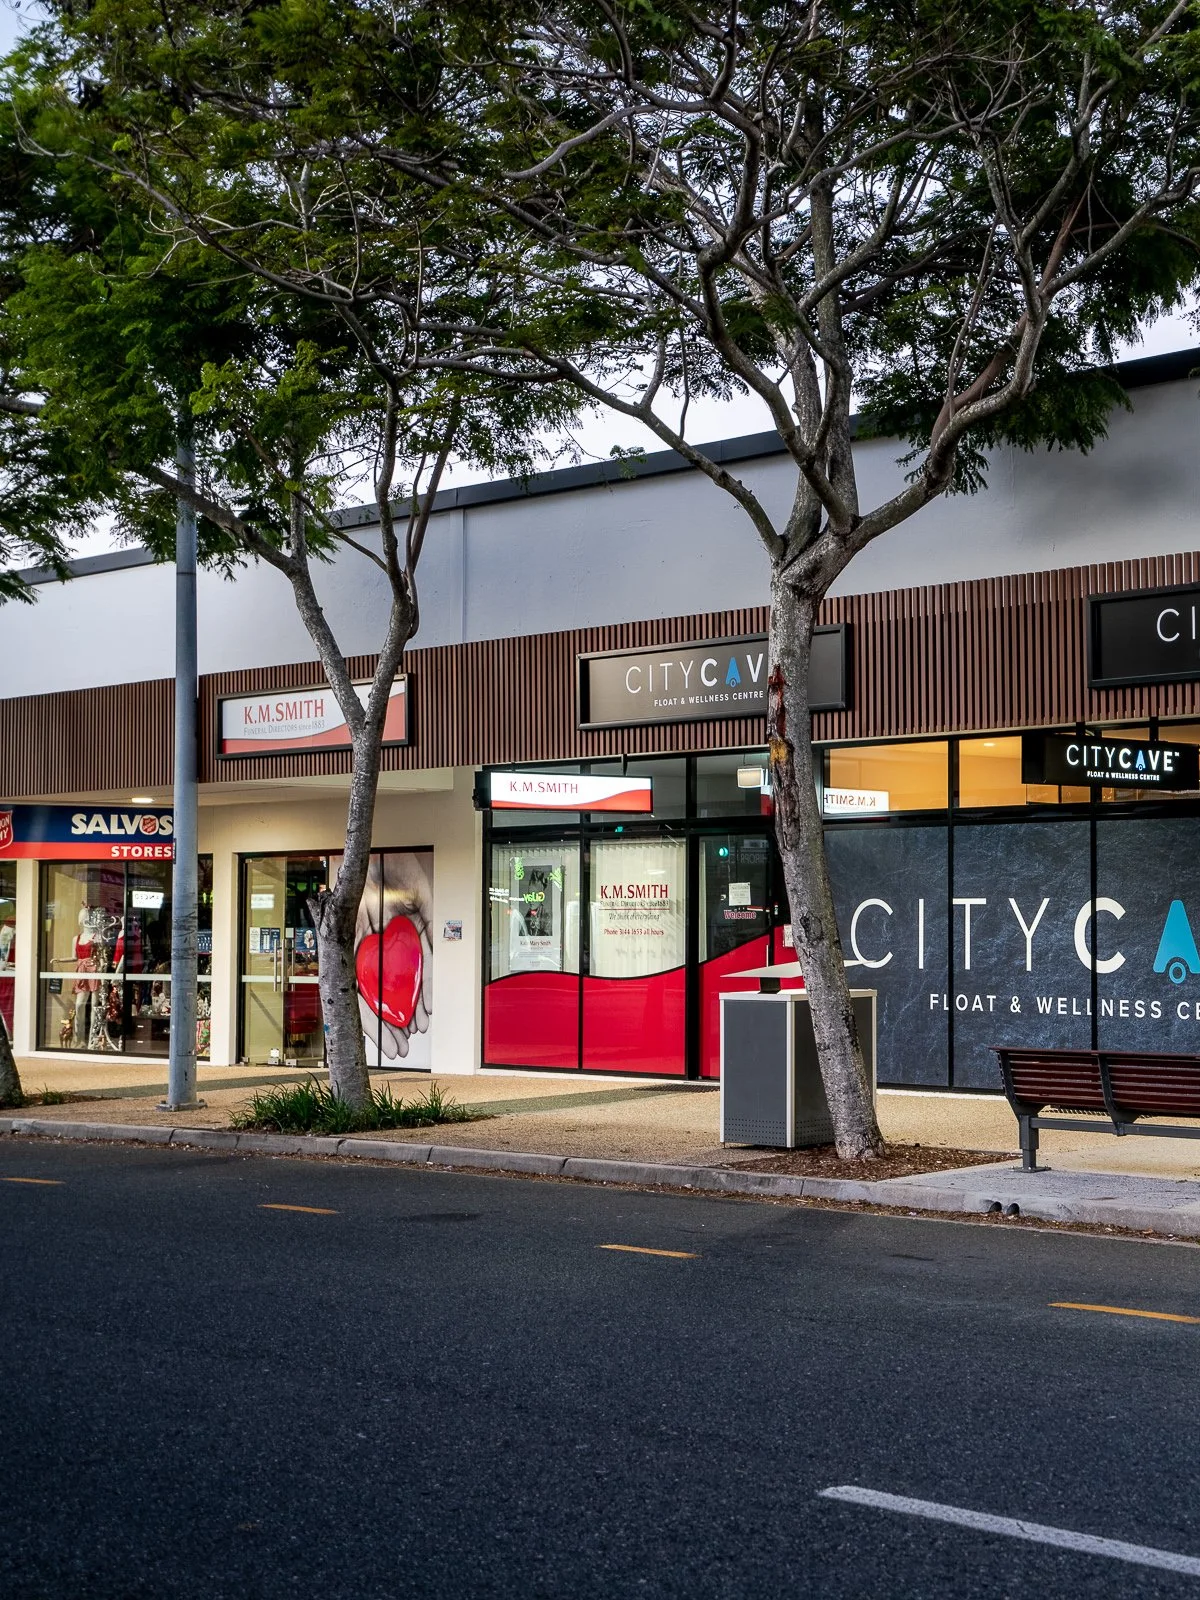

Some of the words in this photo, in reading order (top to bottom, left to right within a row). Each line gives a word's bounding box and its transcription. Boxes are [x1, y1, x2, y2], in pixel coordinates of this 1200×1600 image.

[625, 653, 764, 693] CITYCAV
[654, 698, 677, 707] FLOAT
[680, 696, 686, 705] &
[688, 693, 730, 704] WELLNESS
[732, 690, 764, 700] CENTRE
[244, 699, 324, 725] K.M.SMITH
[1087, 770, 1104, 778] FLOAT
[1111, 772, 1138, 780] WELLNESS
[1139, 773, 1160, 781] CENTRE
[510, 781, 578, 794] K.M.SMITH
[71, 813, 174, 836] SALVOS
[111, 845, 172, 858] STORES
[600, 884, 669, 899] K.M.SMITH
[723, 910, 757, 919] Welcome
[929, 993, 999, 1012] FLOAT
[1010, 995, 1022, 1014] &
[1036, 996, 1162, 1019] WELLNESS
